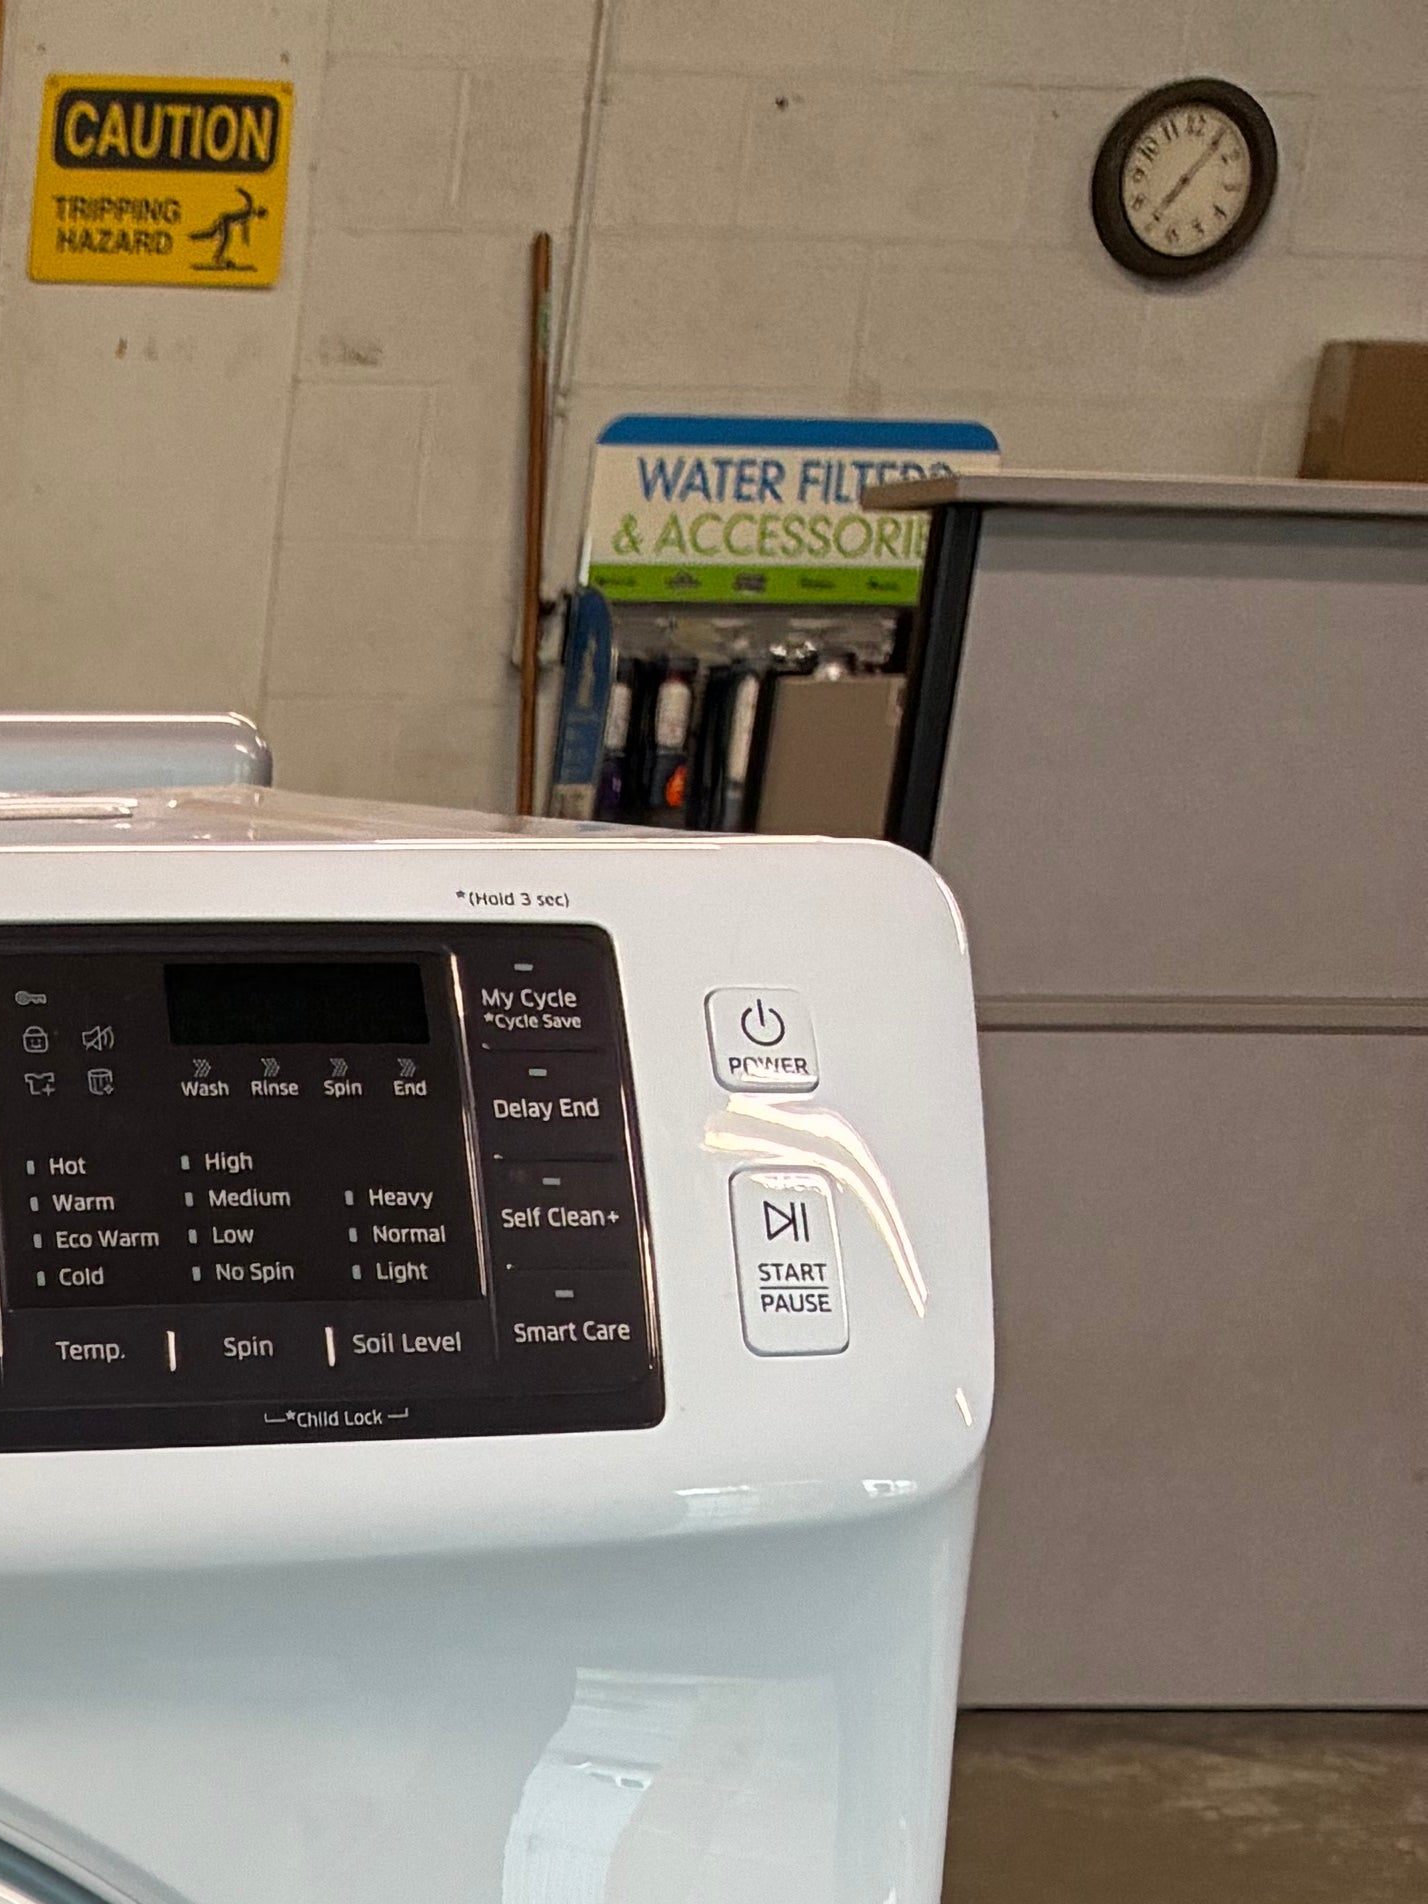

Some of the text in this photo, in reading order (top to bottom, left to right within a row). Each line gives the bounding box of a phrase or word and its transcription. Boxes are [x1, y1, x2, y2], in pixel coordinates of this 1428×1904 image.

[64, 100, 275, 163] CAUTION
[53, 194, 182, 225] TRIPPING
[56, 227, 174, 255] HAZARD
[637, 455, 786, 504] WATER
[612, 512, 642, 557] &
[520, 892, 533, 908] 3
[536, 892, 571, 909] sec)
[481, 986, 578, 1011] My Cycle
[542, 1012, 582, 1030] Save
[729, 1056, 811, 1076] POWER
[181, 1079, 428, 1099] Wash Rinse Spin End
[493, 1097, 601, 1122] Delay End
[49, 1156, 87, 1176] Hot
[205, 1151, 254, 1174] High
[52, 1193, 115, 1212] Warm
[208, 1187, 291, 1208] Medium
[368, 1187, 434, 1210] Heavy
[501, 1206, 620, 1230] Self Clean+
[55, 1229, 160, 1250] Eco Warm
[212, 1226, 255, 1245] Low
[372, 1224, 447, 1244] Normal
[58, 1266, 105, 1286] Cold
[215, 1261, 295, 1284] No Spin
[376, 1260, 429, 1283] Light
[757, 1262, 828, 1283] START
[760, 1293, 833, 1314] PAUSE
[352, 1330, 463, 1356] Soil Level
[513, 1319, 632, 1346] Smart Care
[55, 1340, 127, 1364] Temp.
[223, 1335, 275, 1361] Spin
[345, 1407, 384, 1427] Lock
